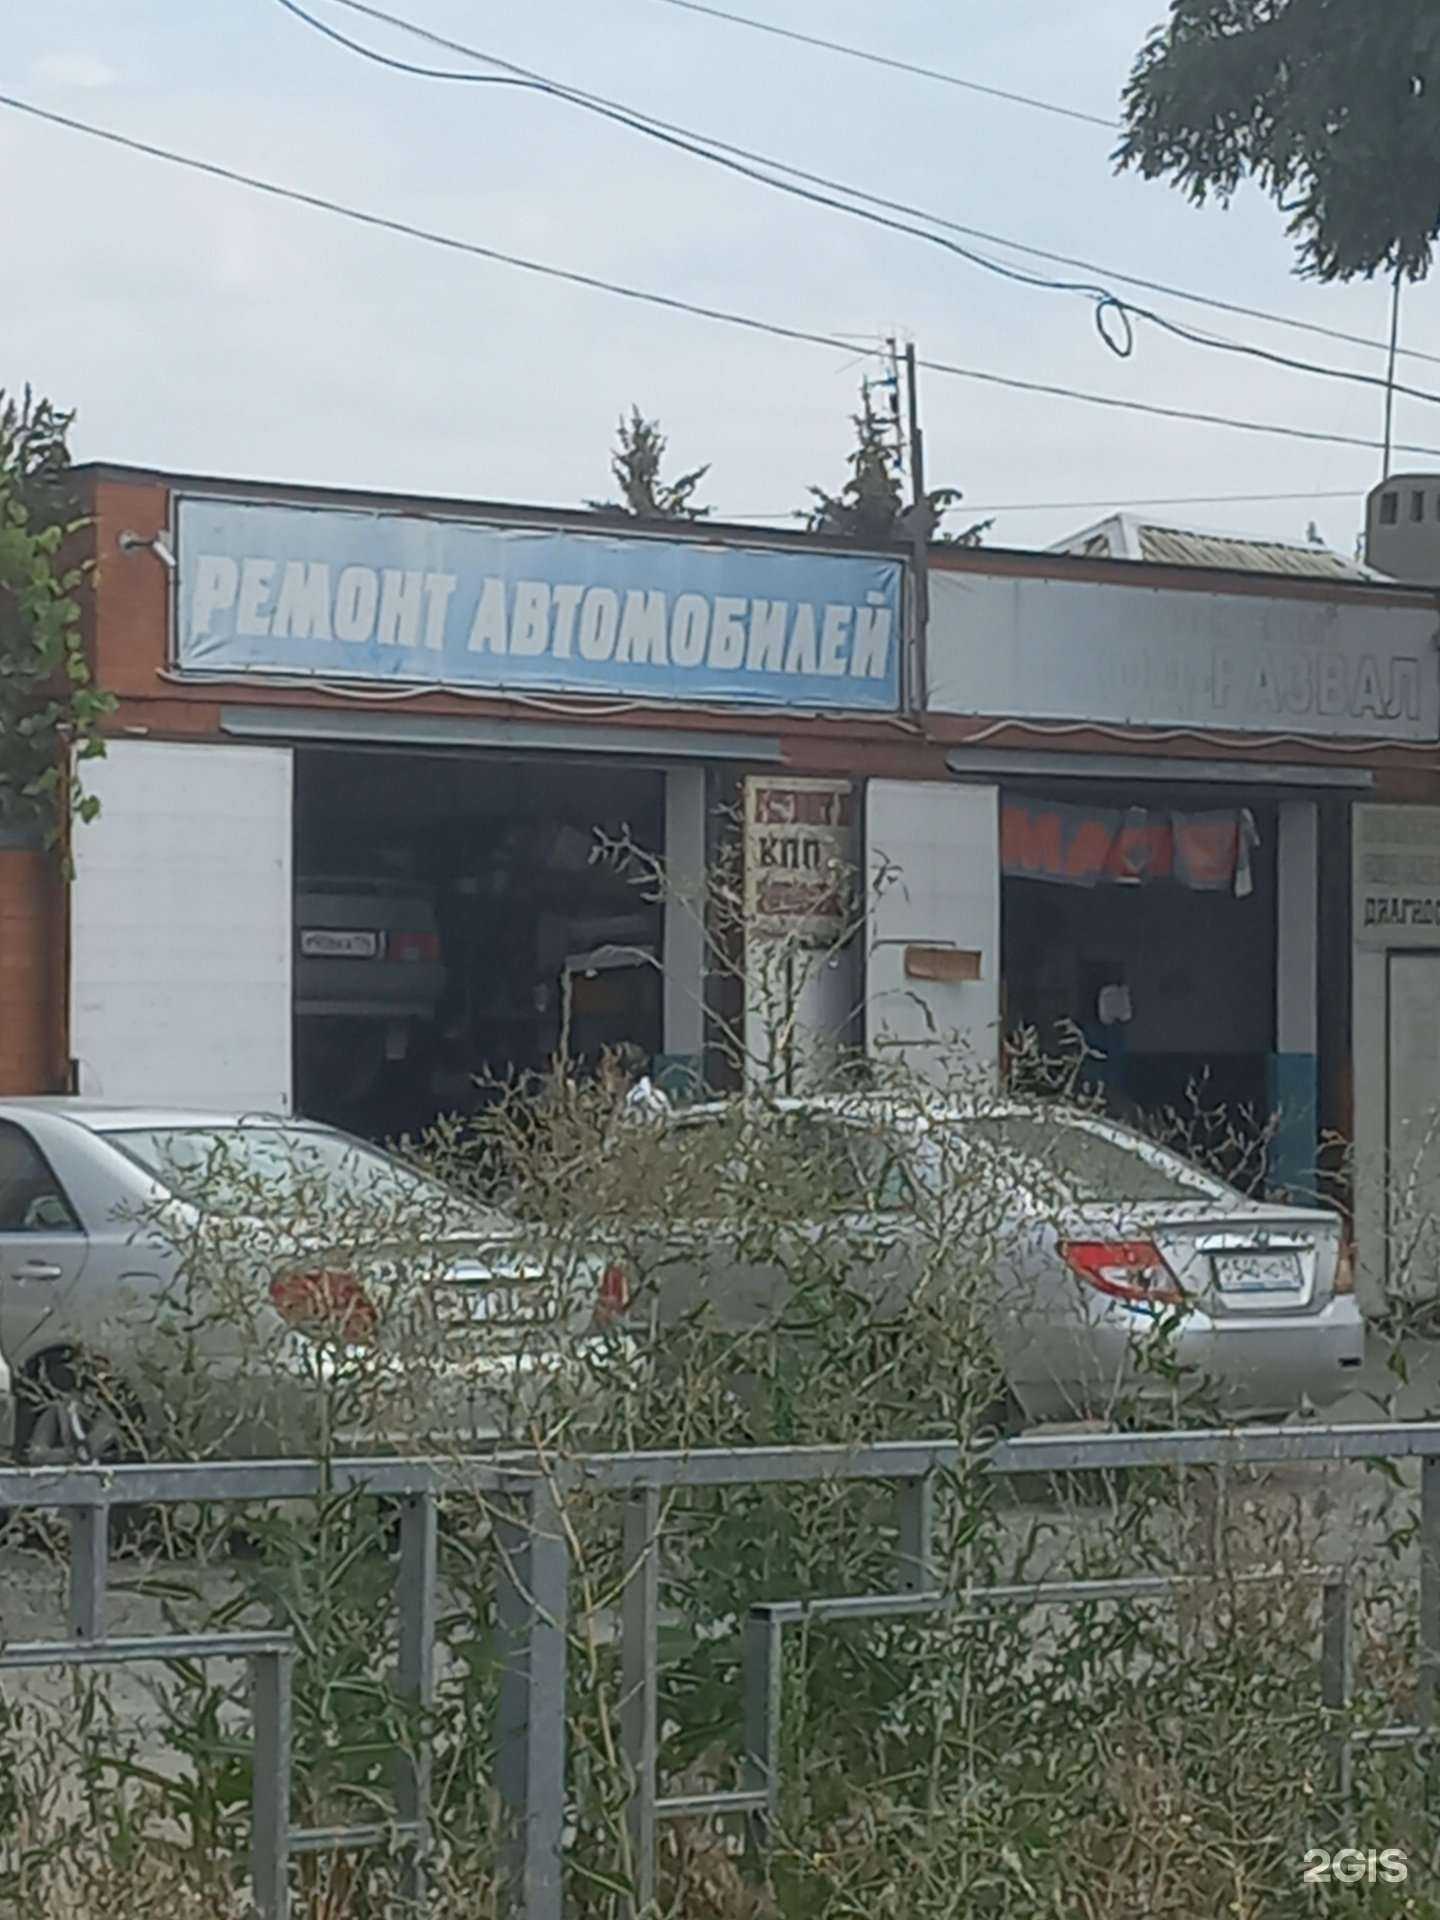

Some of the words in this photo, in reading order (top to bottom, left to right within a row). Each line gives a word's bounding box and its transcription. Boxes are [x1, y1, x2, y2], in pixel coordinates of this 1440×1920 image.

[196, 554, 457, 652] РЕМОНТ
[467, 576, 893, 680] АВТОМОБИЛЕЙ
[758, 833, 820, 869] КПП
